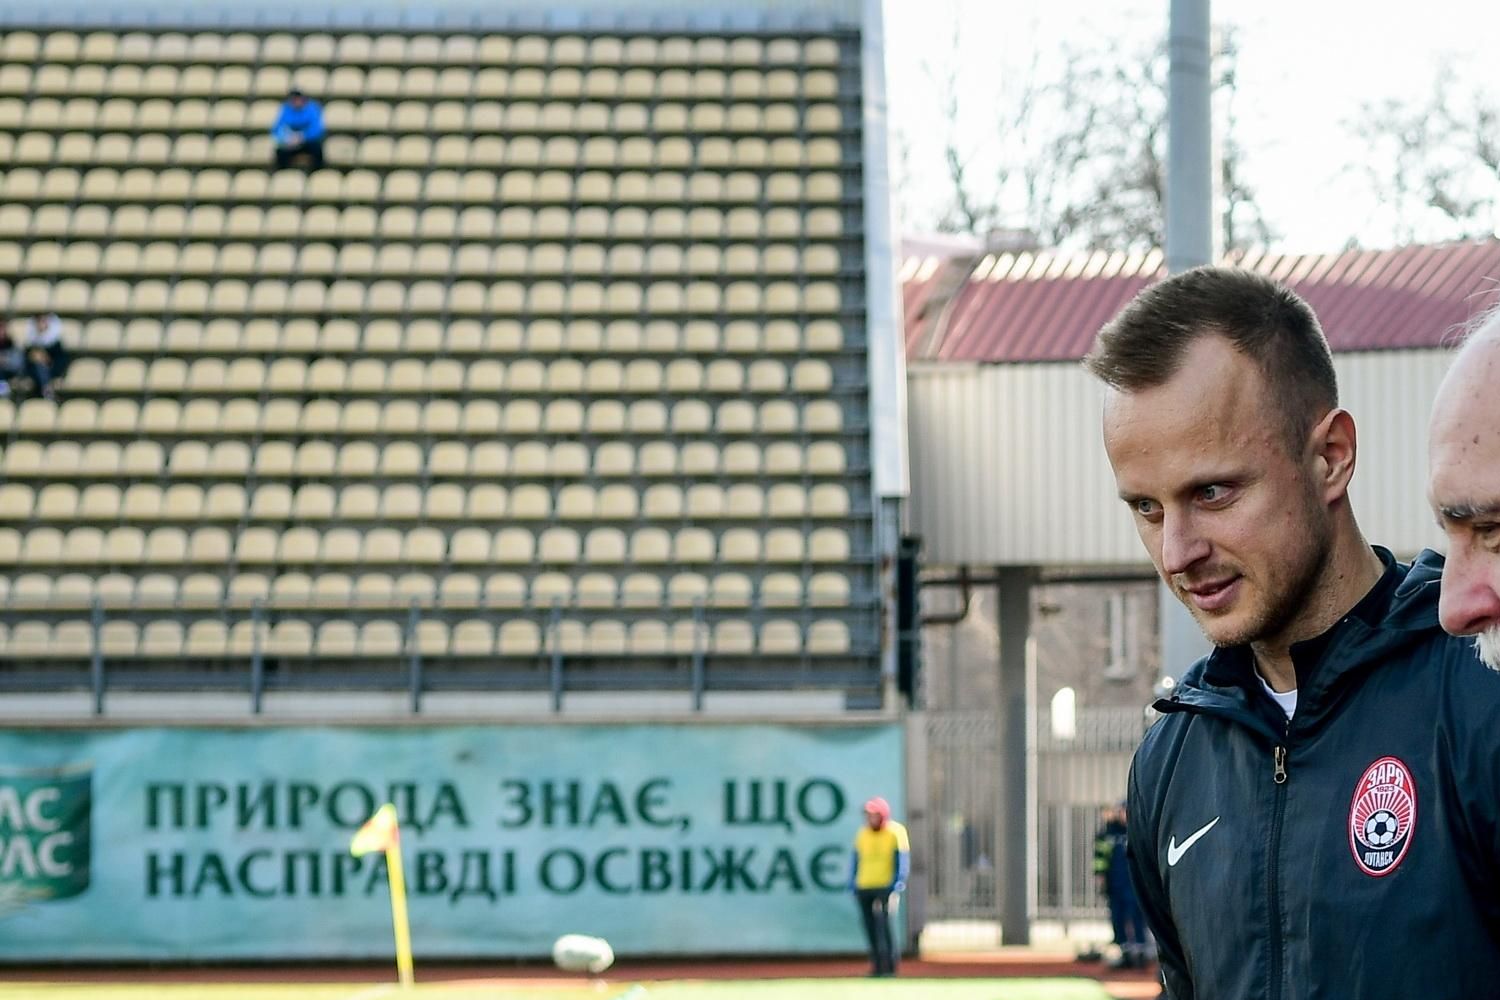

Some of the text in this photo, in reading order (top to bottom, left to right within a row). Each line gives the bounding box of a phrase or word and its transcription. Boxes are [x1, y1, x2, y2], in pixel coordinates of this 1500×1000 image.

[1366, 763, 1405, 789] ЗАРЯ
[146, 778, 846, 836] ПРИРОДА ЗНАЄ, ЩО
[0, 831, 74, 878] АС
[147, 847, 851, 903] НАСПРАВДІ ОСВІЖАЄ
